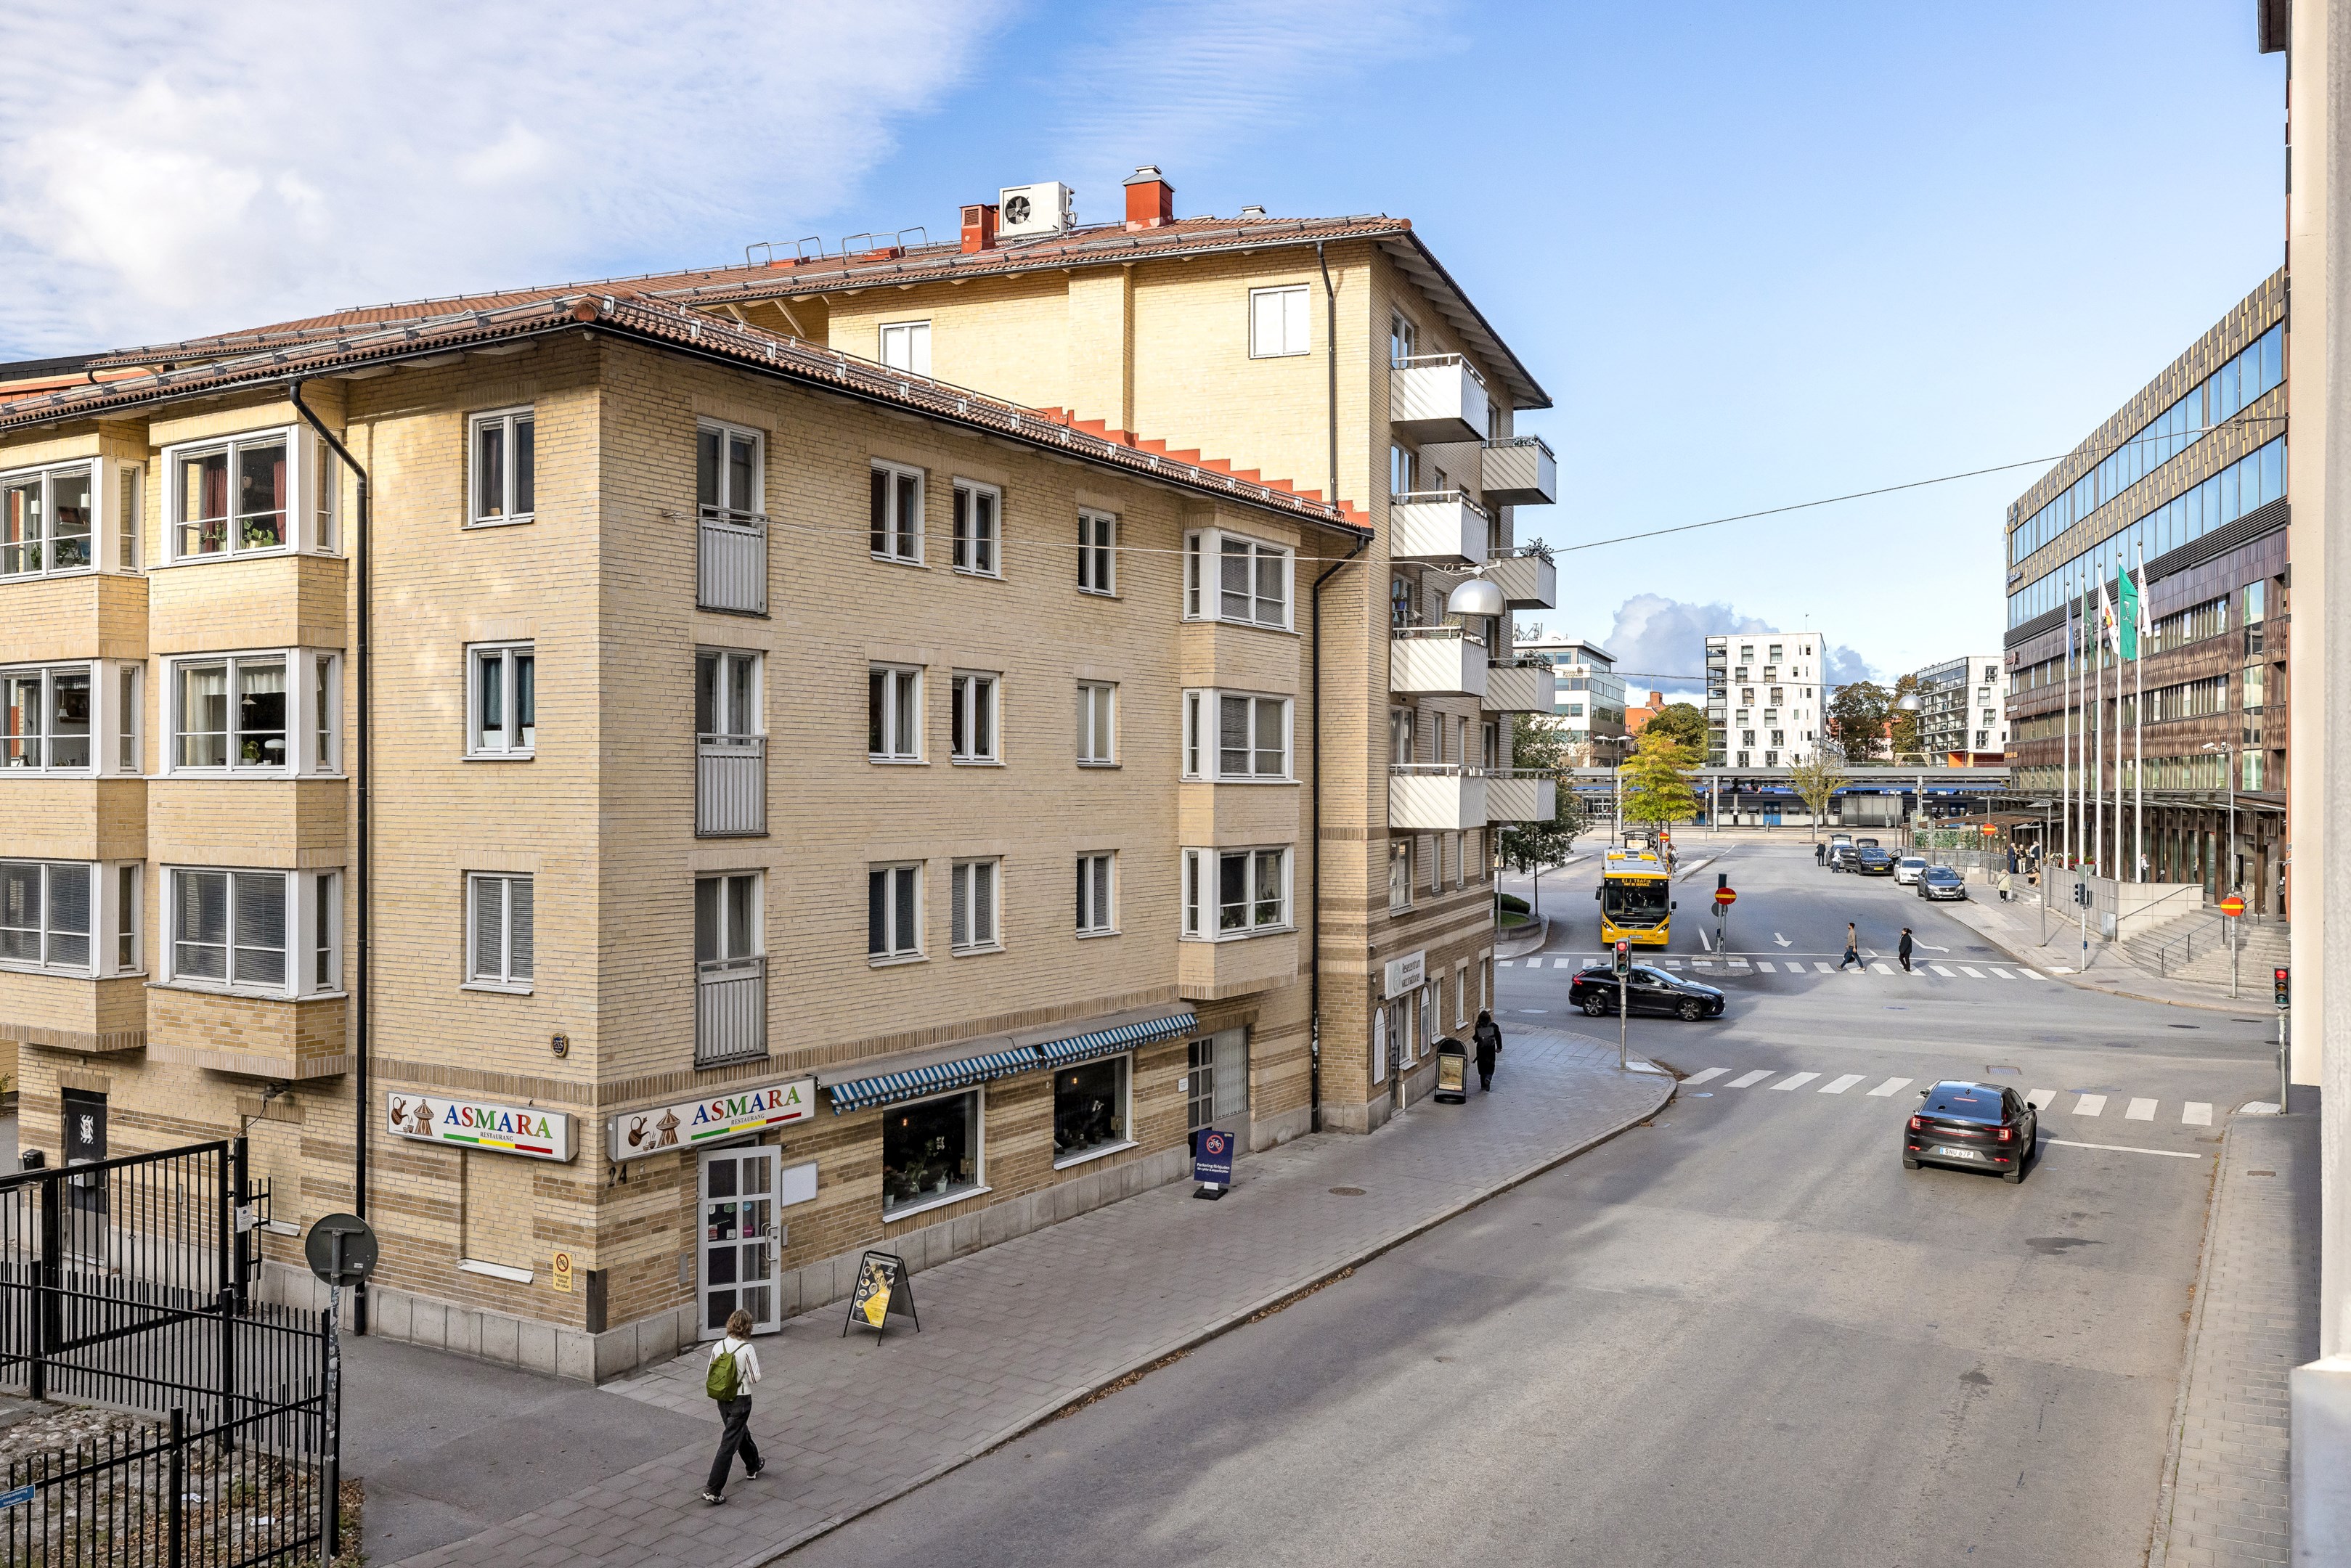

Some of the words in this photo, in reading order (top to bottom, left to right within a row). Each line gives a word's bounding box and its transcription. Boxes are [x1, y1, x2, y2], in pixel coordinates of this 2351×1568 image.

[690, 1085, 802, 1126] ASMARA
[443, 1104, 553, 1139] ASMARA
[730, 1113, 765, 1126] RESTAURANG
[480, 1131, 514, 1143] RESTAURANG
[608, 1164, 627, 1188] 24
